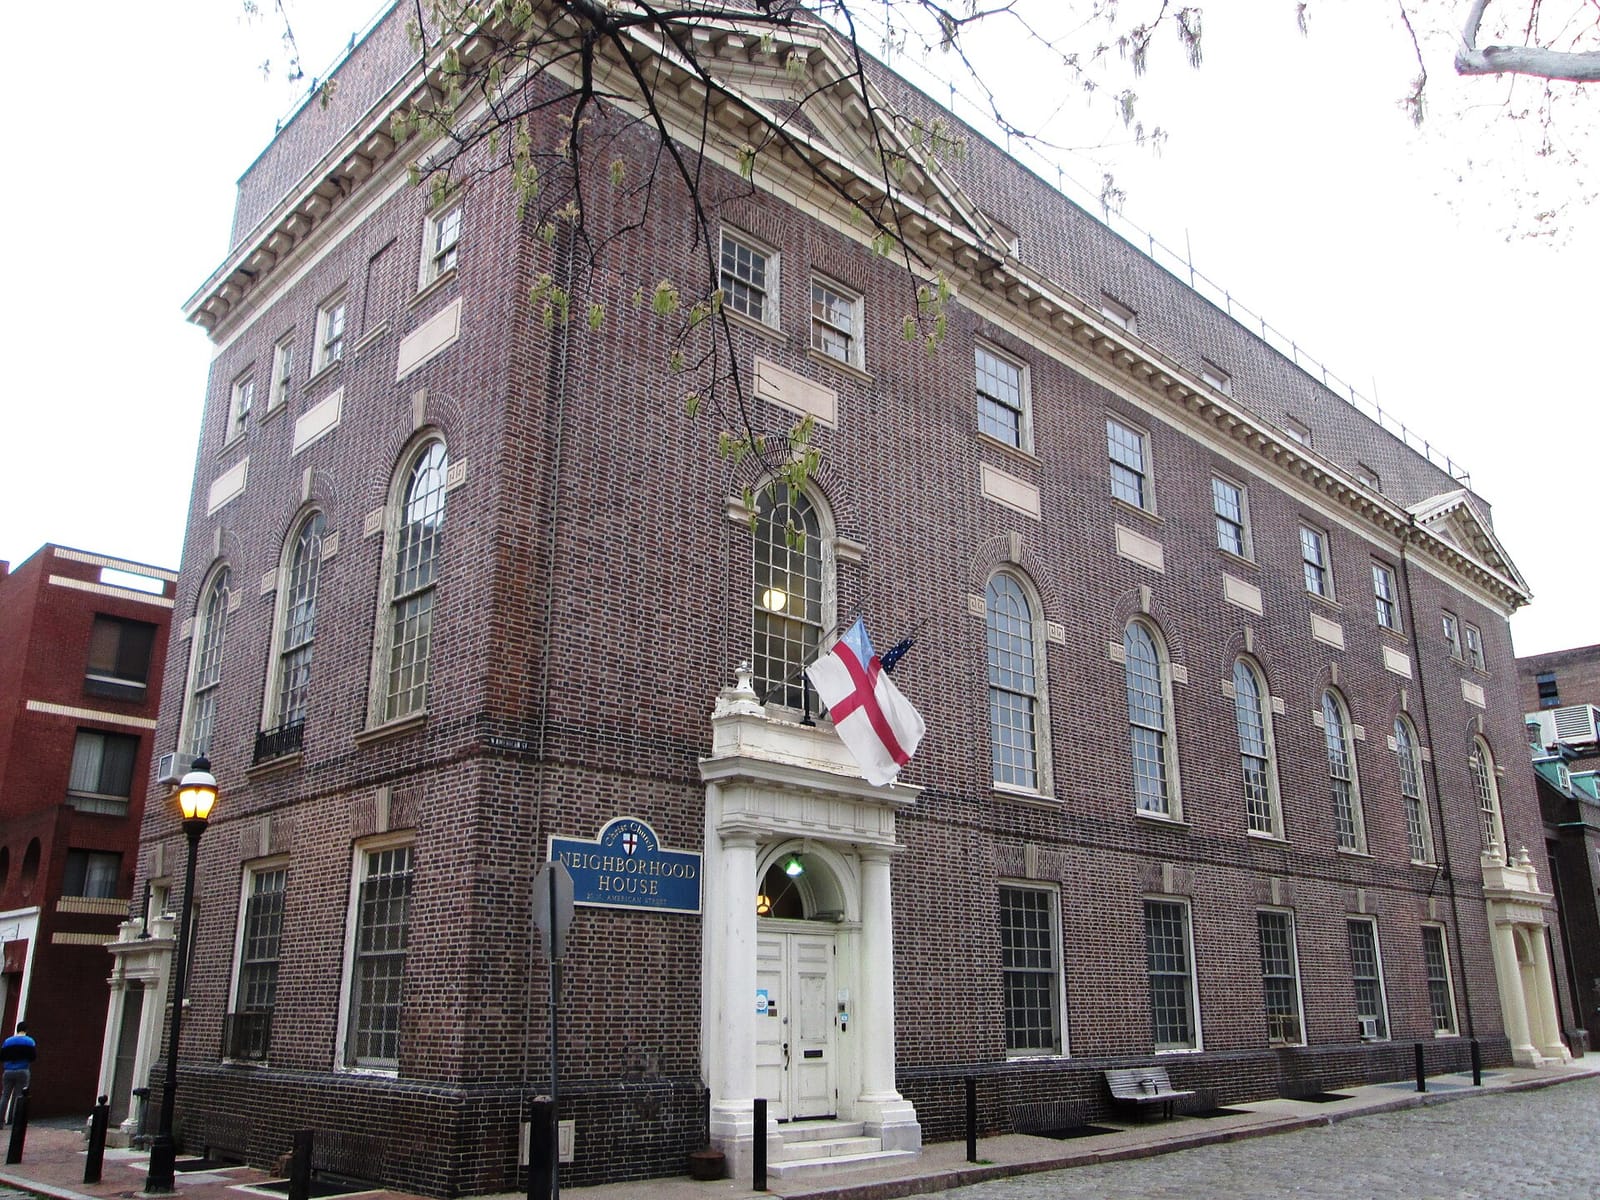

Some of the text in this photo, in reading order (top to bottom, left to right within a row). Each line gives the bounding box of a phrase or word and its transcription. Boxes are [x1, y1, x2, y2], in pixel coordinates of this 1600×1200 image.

[605, 822, 654, 852] Christ Church
[558, 851, 696, 880] NEIGHBORHOOD
[598, 875, 658, 895] HOUSE
[606, 895, 642, 904] AMERICAN
